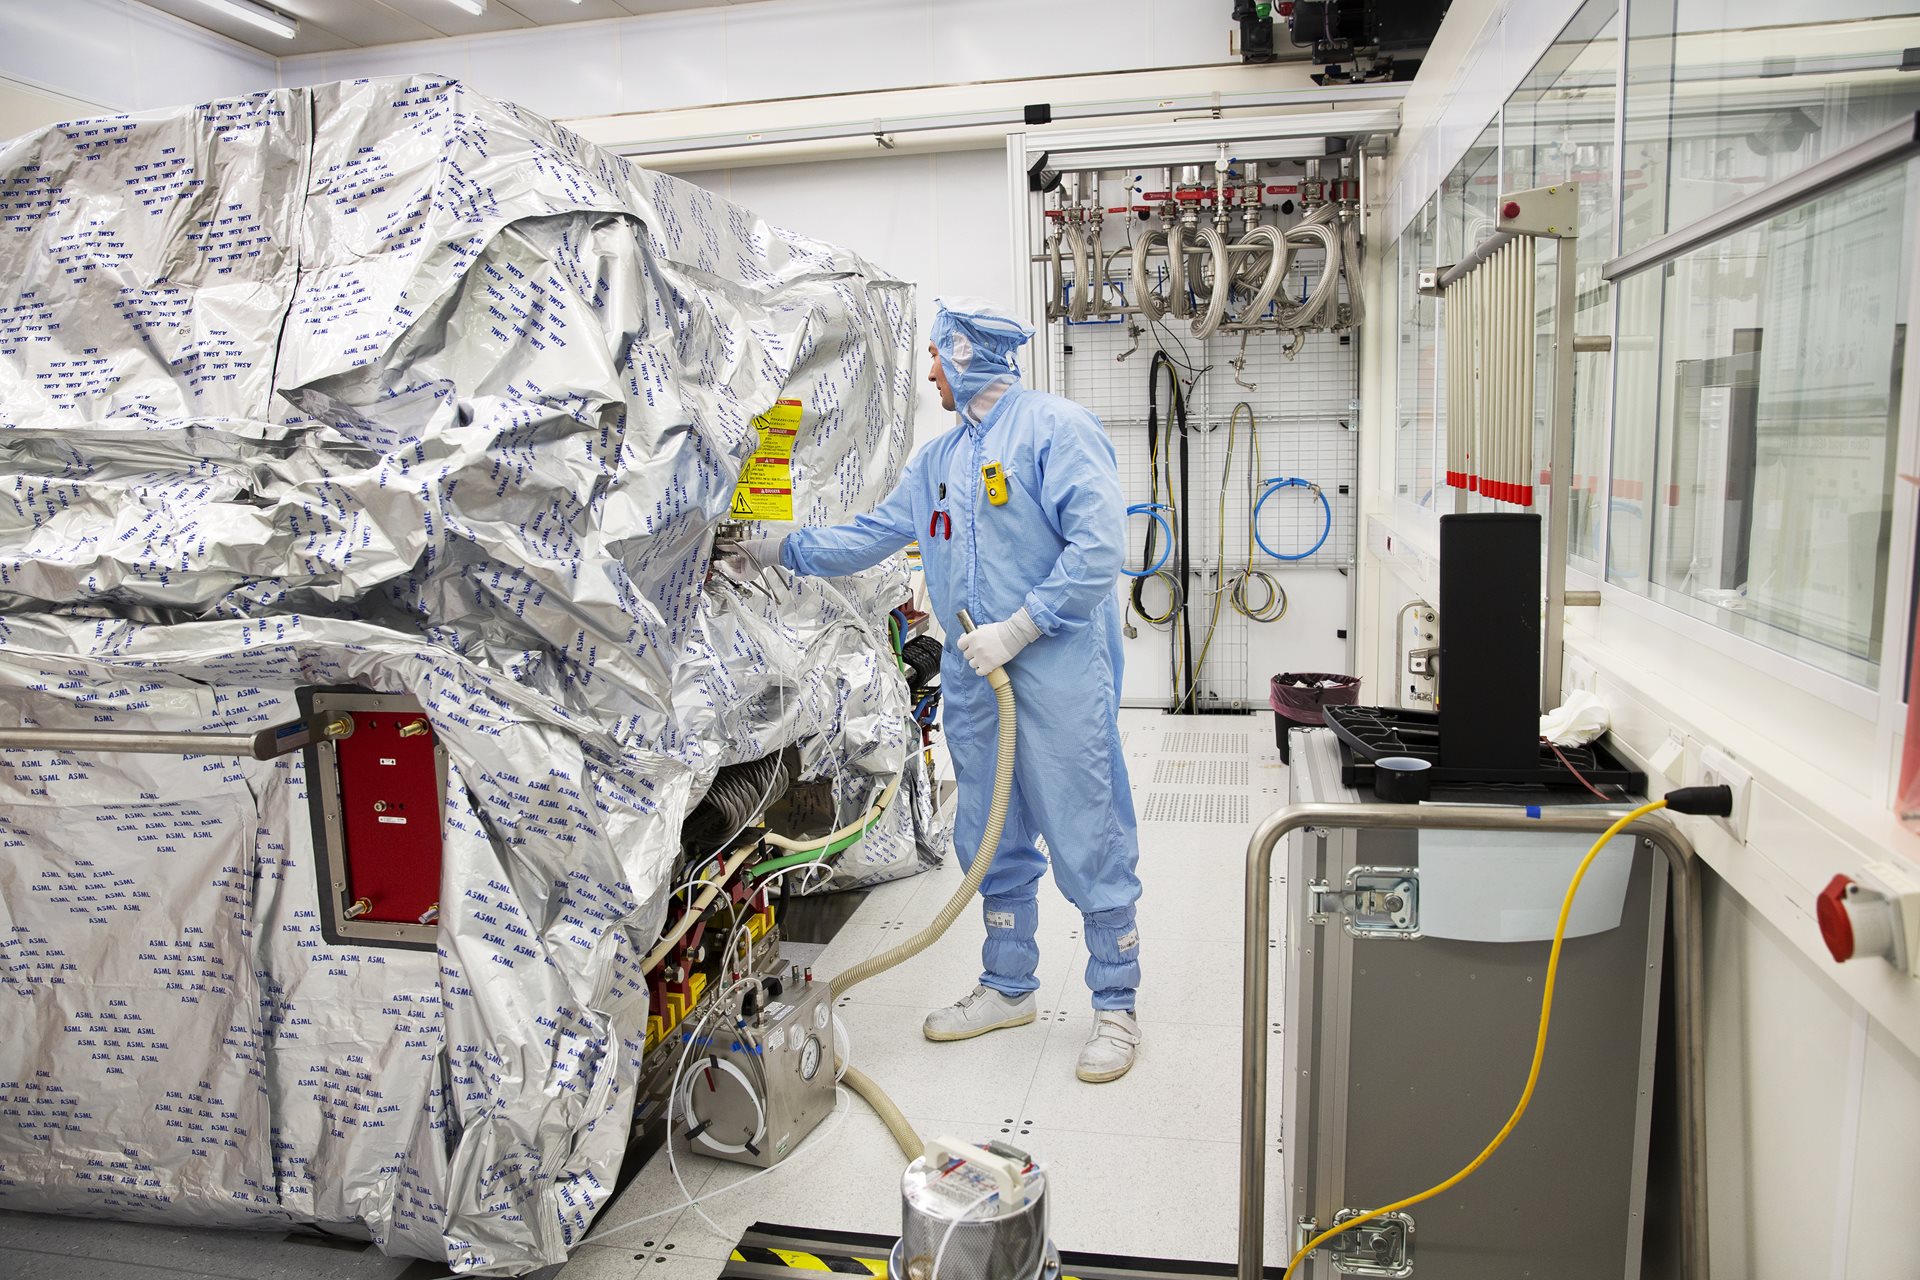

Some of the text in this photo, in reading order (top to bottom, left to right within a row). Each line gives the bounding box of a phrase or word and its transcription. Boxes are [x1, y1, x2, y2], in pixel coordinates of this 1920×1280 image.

[402, 82, 441, 98] ASML ASML
[391, 96, 432, 110] ASML ASML
[64, 124, 138, 140] ASML ASML ASML ASML
[160, 146, 176, 156] ASML
[355, 146, 375, 154] ASML
[343, 158, 362, 168] ASML
[35, 176, 54, 184] ASML
[350, 186, 387, 200] ASML ASML
[36, 200, 54, 208] ASML
[227, 202, 244, 212] ASML
[207, 224, 262, 240] ASML ASML ASML
[397, 224, 415, 236] ASML
[217, 242, 233, 250] ASML
[255, 234, 272, 244] ASML
[216, 264, 233, 276] ASML
[483, 260, 526, 282] ASML ASML
[528, 280, 548, 296] ASML
[547, 276, 566, 292] ASML
[483, 282, 506, 302] ASML
[547, 294, 567, 310] ASML
[393, 304, 414, 318] ASML
[486, 304, 509, 322] ASML
[548, 312, 568, 328] ASML
[490, 326, 510, 342] ASML
[548, 332, 568, 348] ASML
[363, 344, 380, 352] ASML
[351, 358, 368, 366] ASML
[640, 362, 650, 382] ASML
[628, 376, 640, 400] ASML
[645, 388, 655, 408] ASML
[282, 416, 304, 426] ASML
[334, 422, 354, 430] ASML
[615, 414, 628, 436] ASML
[585, 440, 594, 462] ASML
[26, 486, 37, 508] ASML
[664, 488, 672, 506] ASML
[655, 502, 663, 520] ASML
[288, 512, 303, 538] ASML
[116, 526, 139, 542] ASML
[180, 550, 191, 576] ASML
[680, 558, 689, 576] ASML
[700, 558, 709, 574] ASML
[686, 568, 695, 586] ASML
[684, 592, 692, 610] ASML
[514, 598, 526, 622] ASML
[671, 606, 679, 622] ASML
[575, 630, 585, 652] ASML
[587, 644, 597, 668] ASML
[433, 666, 455, 682] ASML
[107, 688, 130, 698] ASML
[138, 682, 167, 692] ASML
[236, 688, 261, 698] ASML
[460, 682, 483, 696] ASML
[439, 688, 462, 704] ASML
[122, 700, 151, 714] ASML
[257, 698, 282, 710] ASML
[467, 704, 492, 718] ASML
[225, 706, 250, 718] ASML
[246, 714, 270, 722] ASML
[446, 712, 470, 728] ASML
[476, 724, 502, 736] ASML
[50, 758, 72, 766] ASML
[202, 762, 226, 772] ASML
[38, 772, 90, 782] ASML ASML
[222, 770, 247, 784] ASML
[548, 768, 571, 780] ASML
[527, 780, 551, 792] ASML
[557, 786, 580, 800] ASML
[537, 798, 560, 808] ASML
[517, 810, 540, 822] ASML
[567, 804, 589, 820] ASML
[200, 816, 224, 828] ASML
[545, 816, 569, 828] ASML
[113, 878, 136, 886] ASML
[486, 880, 510, 894] ASML
[104, 892, 126, 900] ASML
[132, 890, 152, 898] ASML
[464, 888, 519, 916] ASML ASML
[472, 912, 528, 938] ASML ASML
[148, 940, 217, 950] ASML ASML ASML
[480, 932, 506, 948] ASML
[138, 952, 158, 960] ASML
[163, 954, 181, 962] ASML
[311, 954, 386, 966] ASML ASML ASML
[152, 968, 217, 978] ASML ASML ASML
[327, 966, 349, 976] ASML
[392, 994, 413, 1002] ASML
[113, 1026, 131, 1034] ASML
[105, 1066, 125, 1074] ASML
[376, 1104, 401, 1114] ASML
